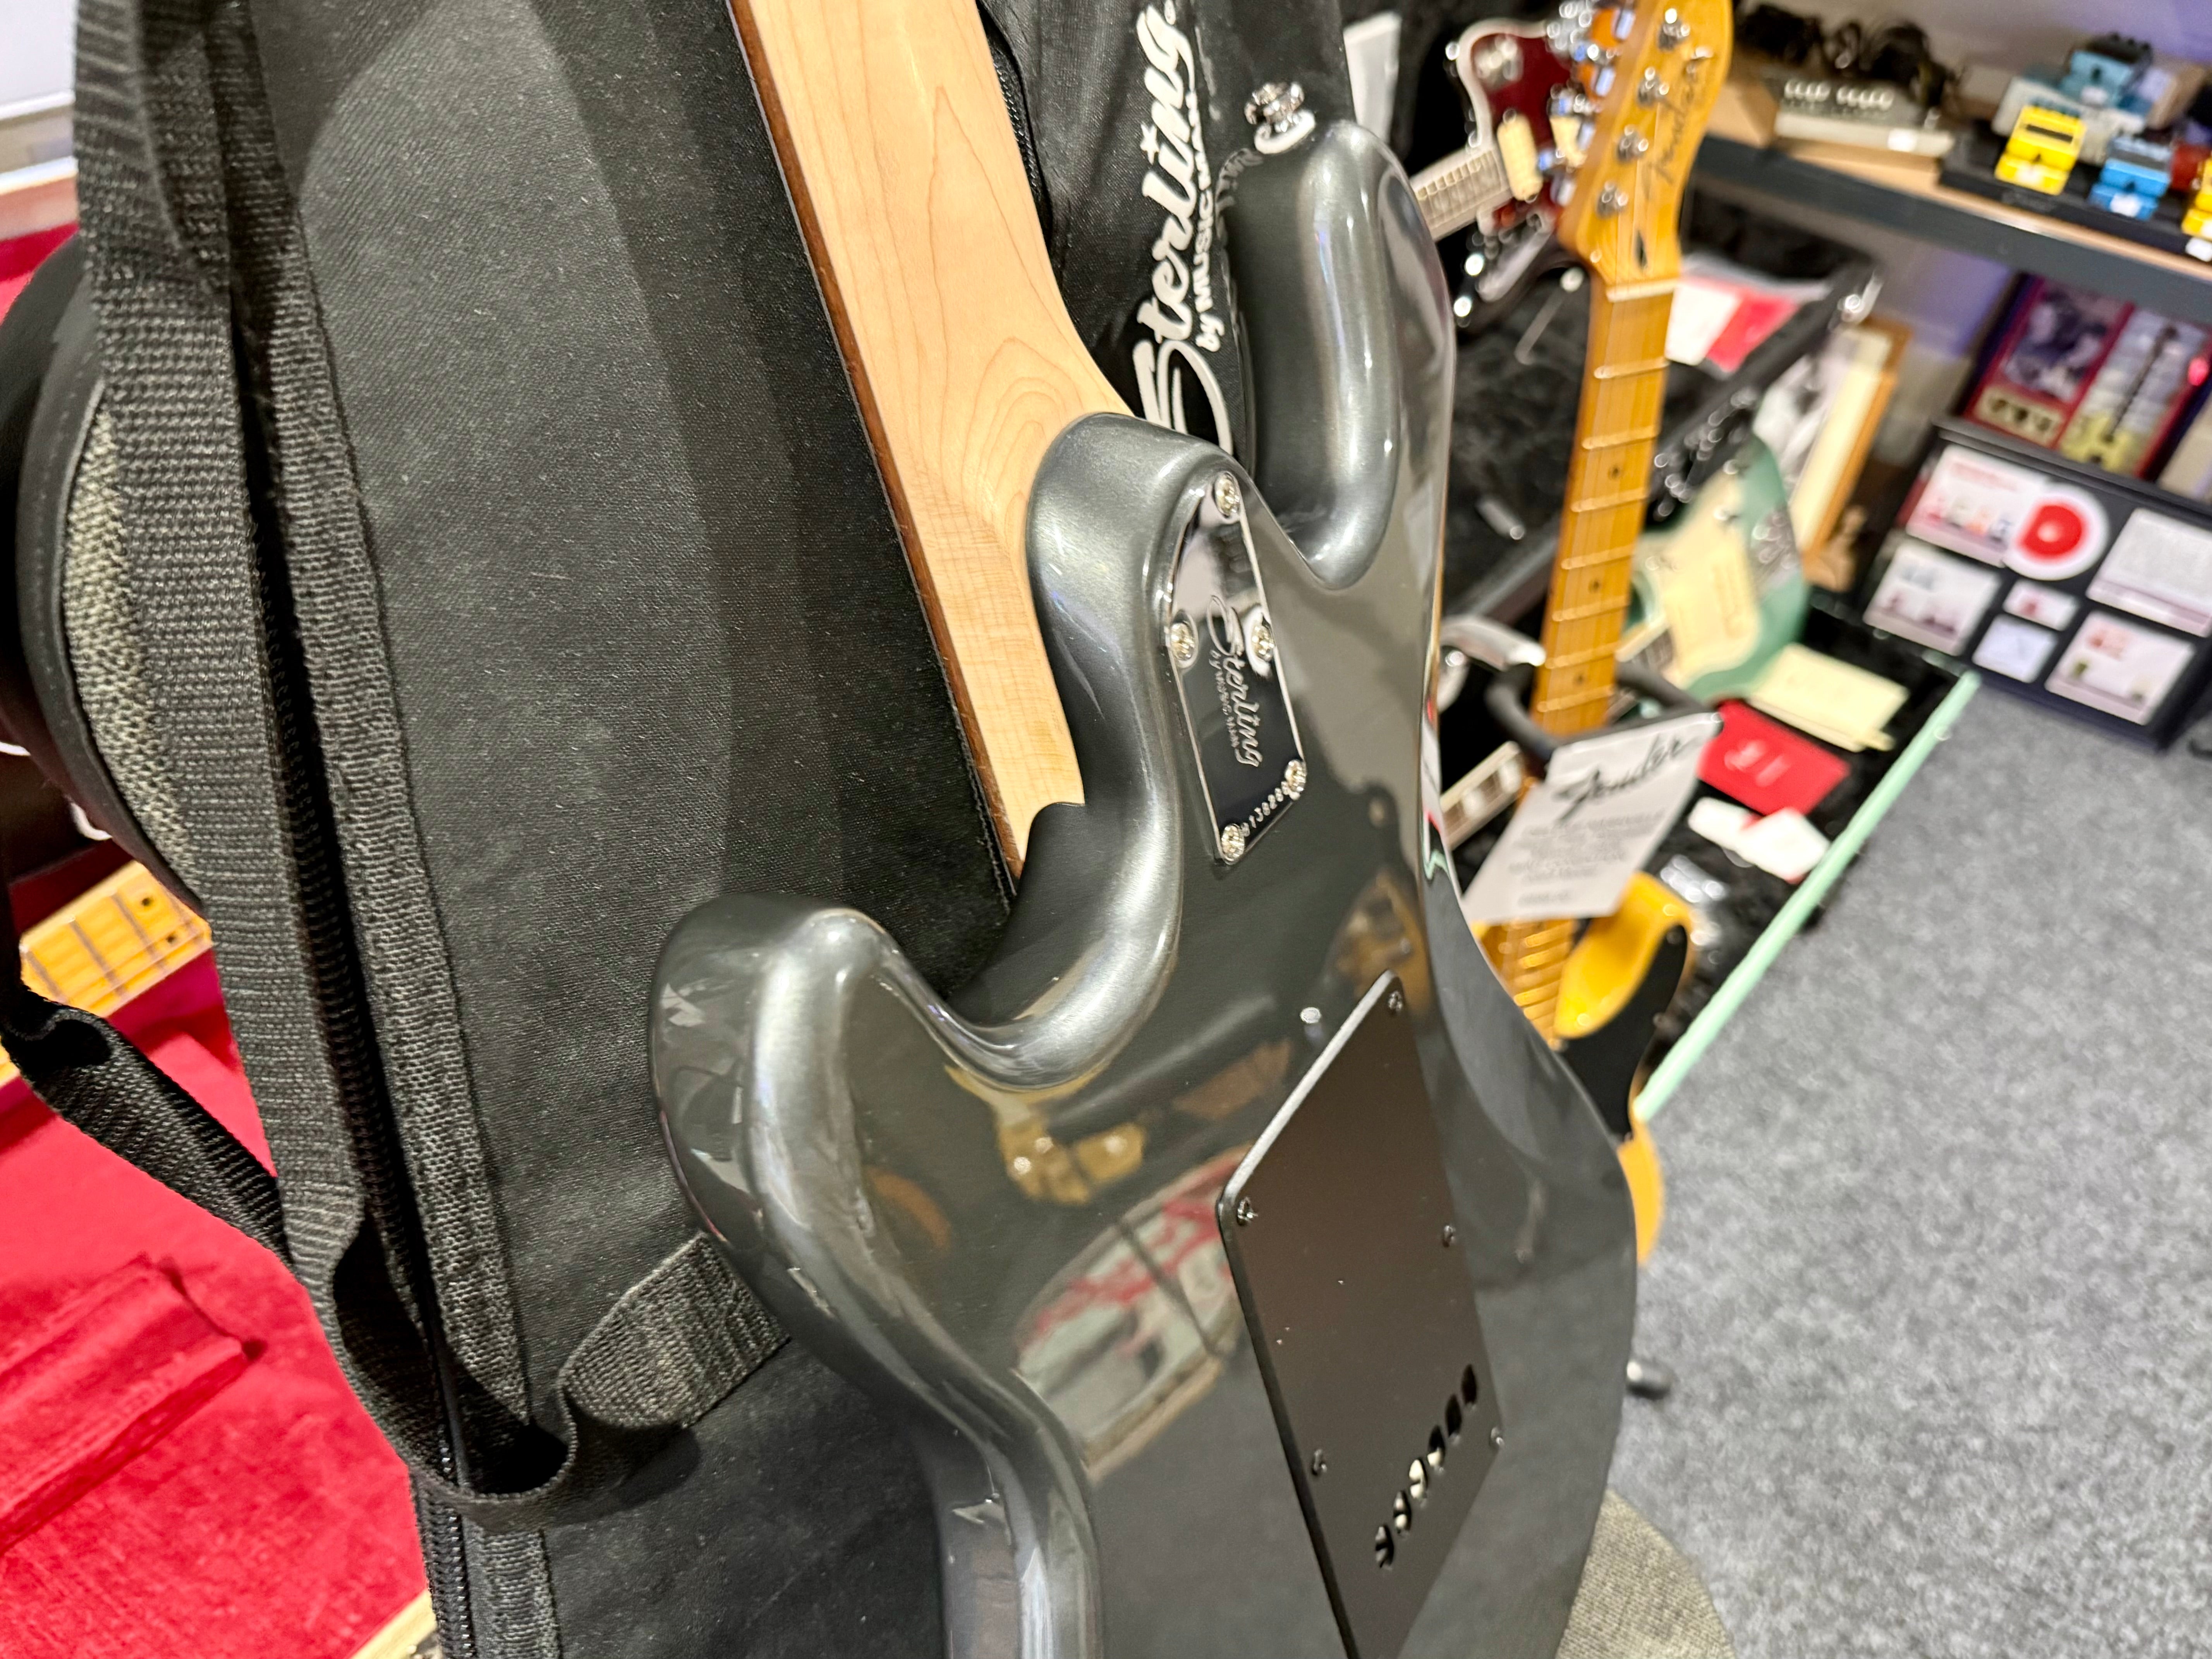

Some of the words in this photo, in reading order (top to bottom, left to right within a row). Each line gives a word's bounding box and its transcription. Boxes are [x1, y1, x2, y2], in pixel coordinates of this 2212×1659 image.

[1135, 4, 1233, 456] Sterling
[1193, 191, 1214, 312] MUSIC
[1195, 313, 1225, 352] by
[1206, 594, 1262, 767] Sterling
[1209, 649, 1222, 670] by
